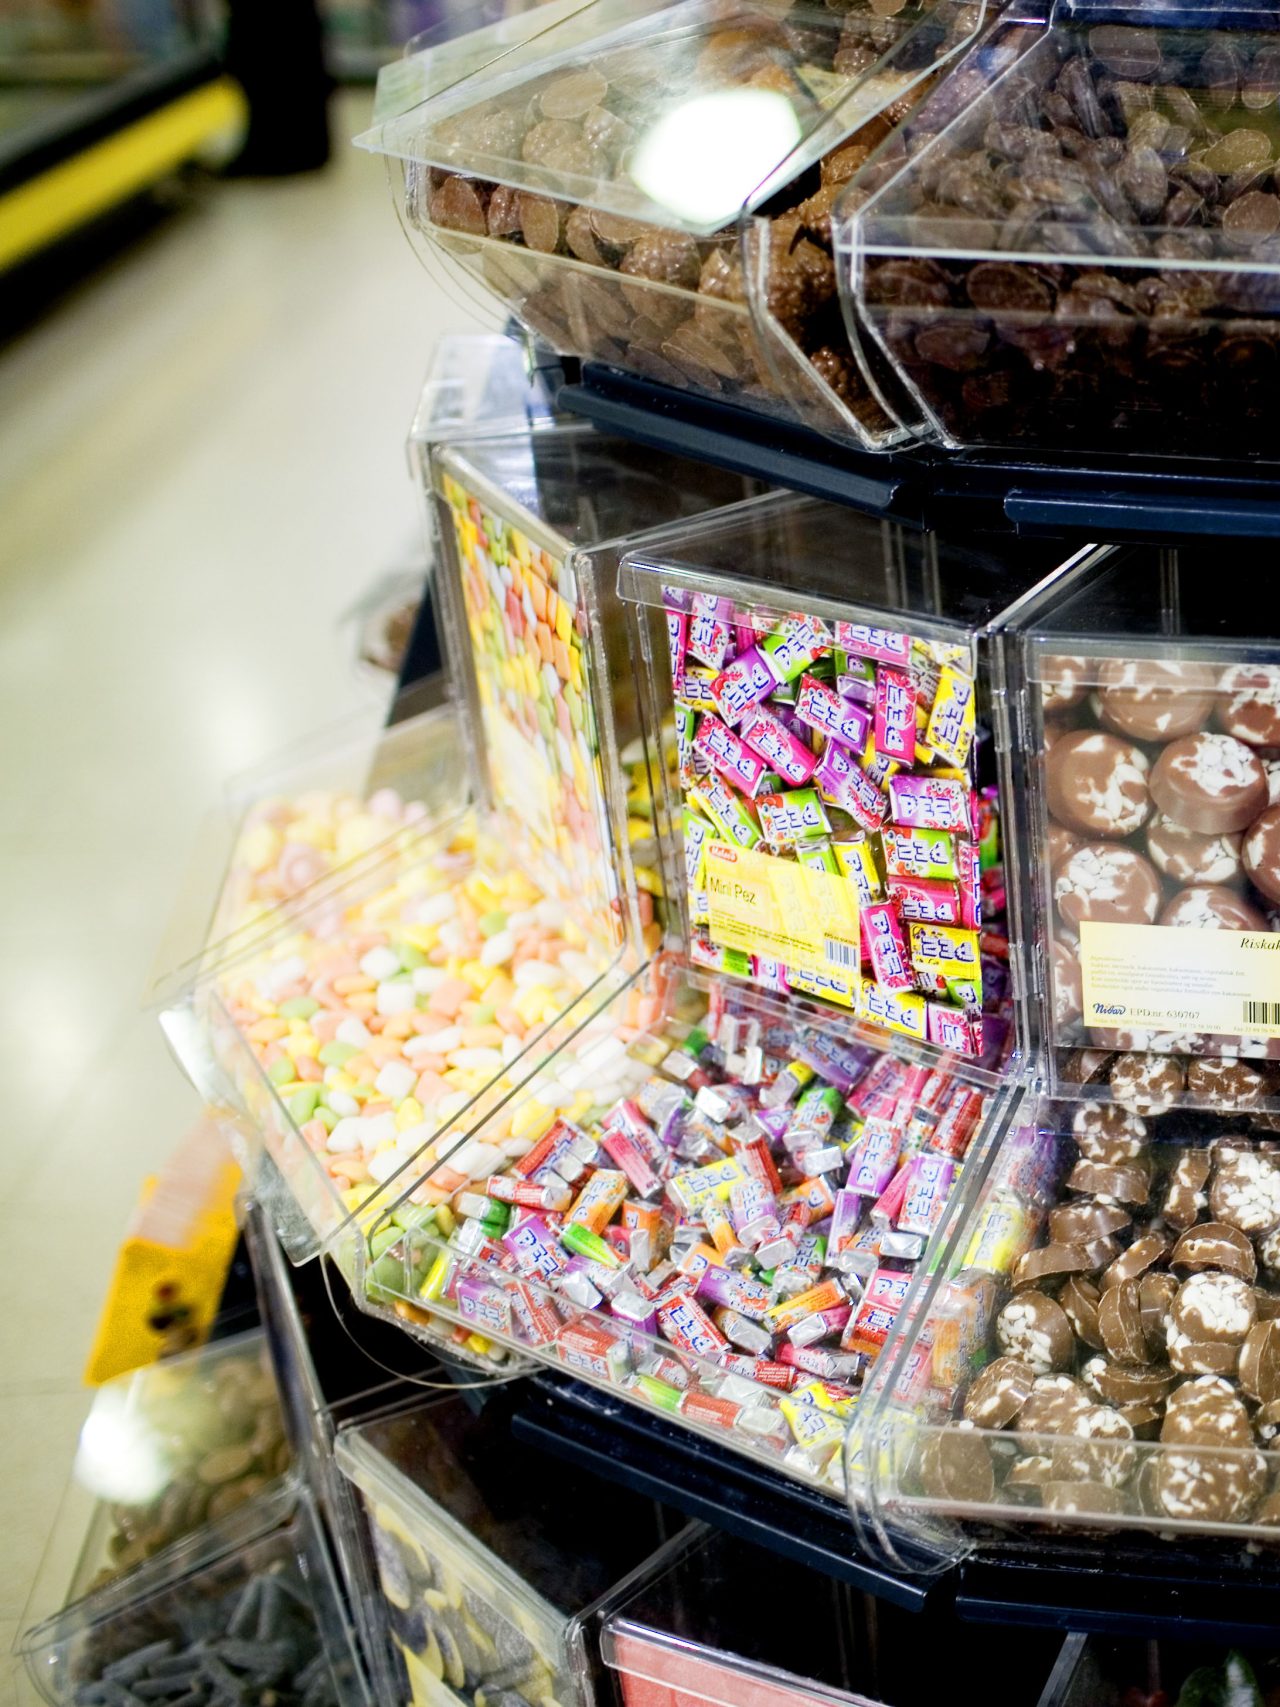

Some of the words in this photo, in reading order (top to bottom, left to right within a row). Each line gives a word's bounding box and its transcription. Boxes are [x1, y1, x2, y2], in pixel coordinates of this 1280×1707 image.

[724, 663, 770, 712] PEZ
[808, 695, 860, 743] PEZ
[885, 684, 904, 751] PEZ
[940, 680, 971, 745] PEZ
[708, 729, 757, 781] PEZ
[758, 732, 807, 782] PEZ
[771, 802, 820, 831] PEZ
[900, 793, 953, 818] PEZ
[896, 840, 948, 864] PEZ
[735, 884, 757, 905] Pez
[901, 900, 954, 922] PEZ
[871, 910, 902, 976] PEZ
[920, 936, 975, 962] PEZ
[869, 993, 918, 1030] PEZ
[514, 1228, 559, 1277] PEZ
[669, 1306, 711, 1354] PEZ
